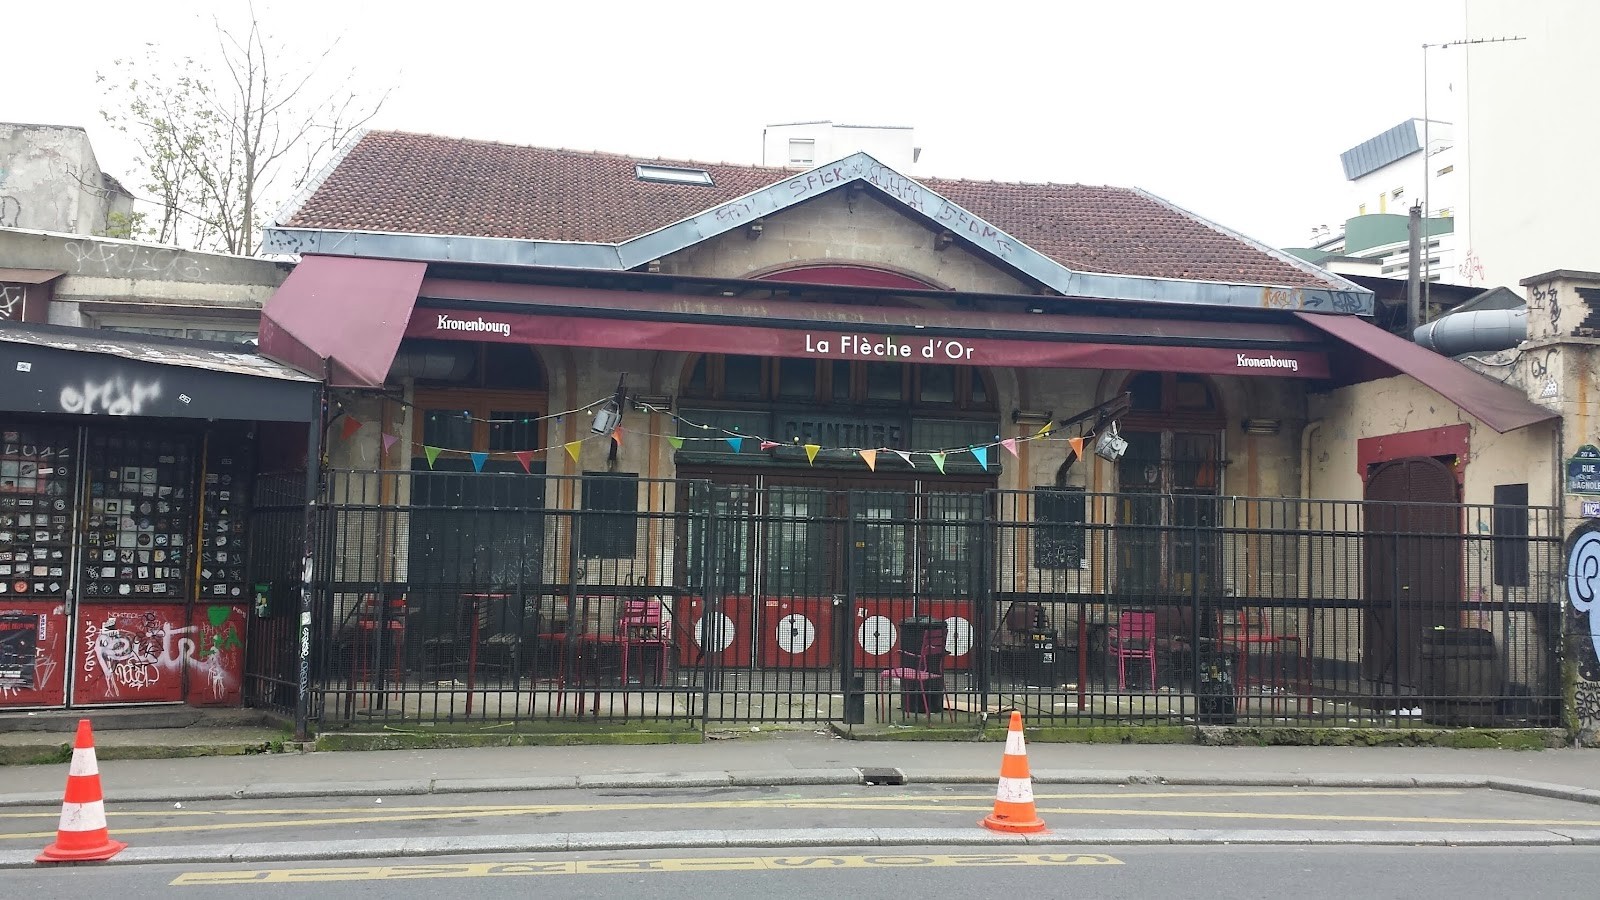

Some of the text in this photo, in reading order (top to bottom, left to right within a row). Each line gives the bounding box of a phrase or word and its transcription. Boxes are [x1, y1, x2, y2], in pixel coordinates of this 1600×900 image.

[437, 315, 511, 337] Kronenbourg
[805, 334, 975, 360] La Flèche d'Or
[1236, 353, 1298, 372] Kronenbourg
[1581, 464, 1595, 473] RUE
